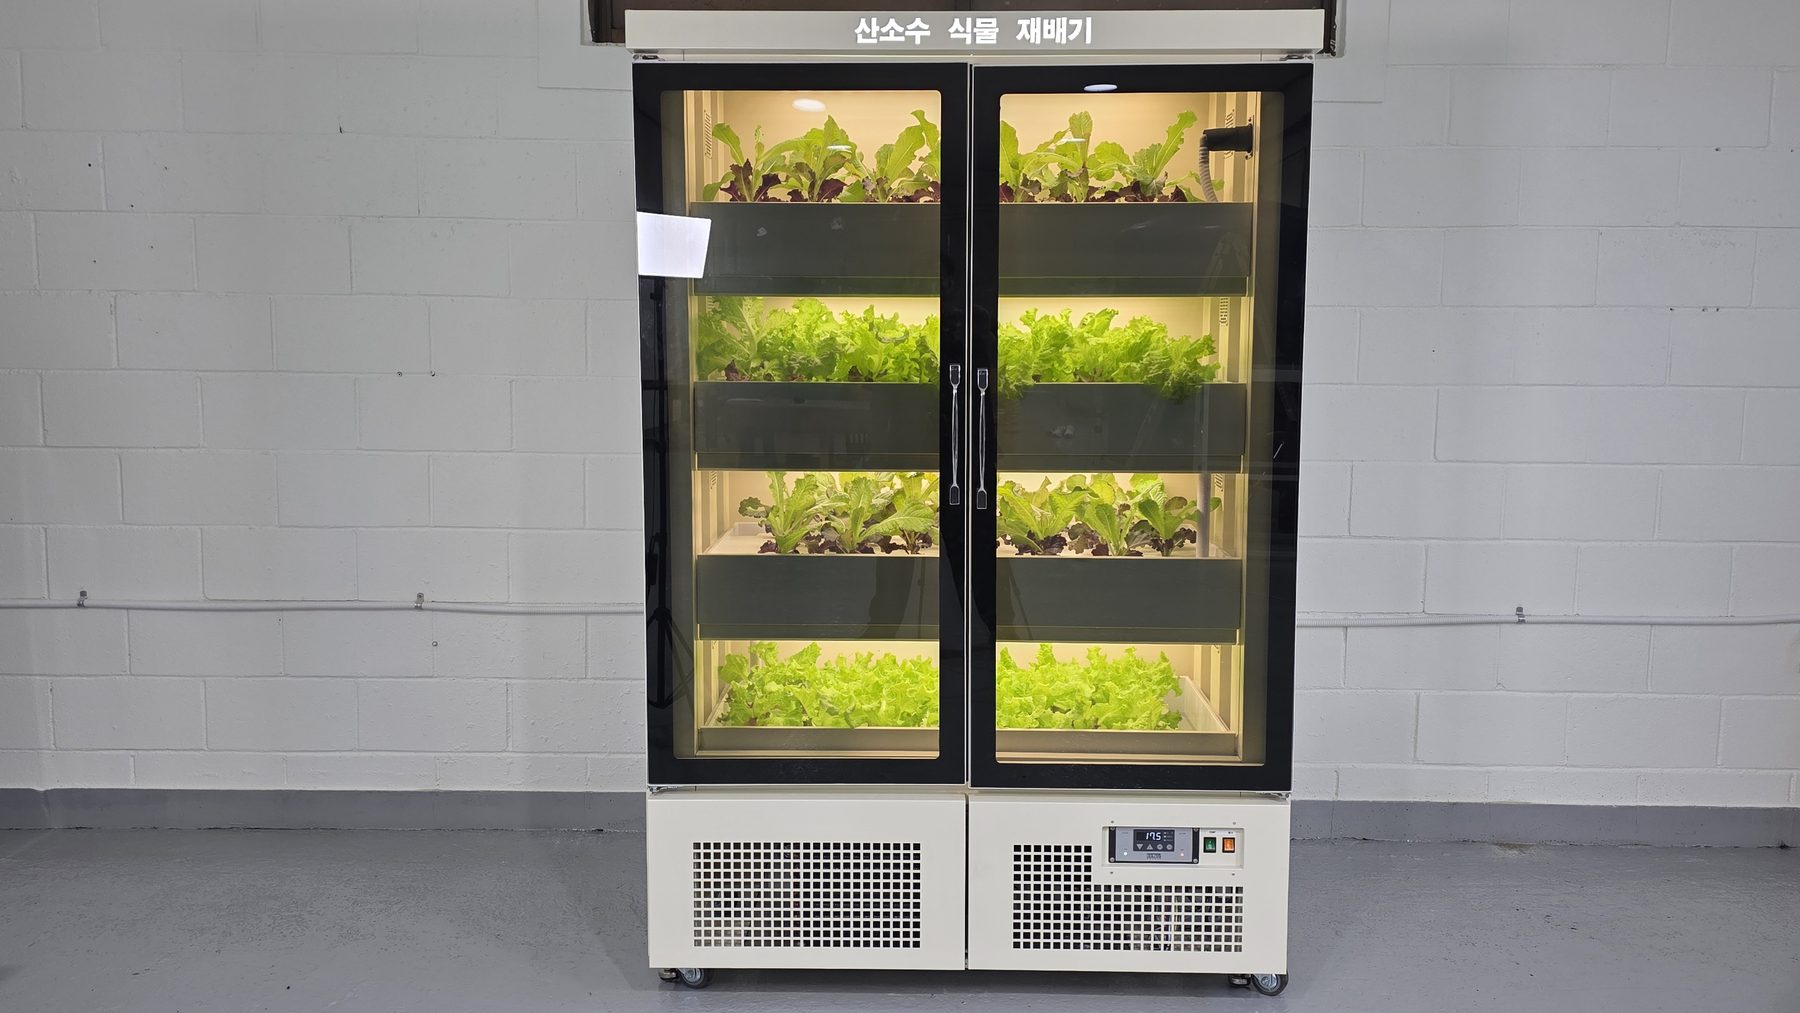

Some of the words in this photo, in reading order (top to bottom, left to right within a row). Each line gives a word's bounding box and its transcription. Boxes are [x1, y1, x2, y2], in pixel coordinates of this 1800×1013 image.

[854, 17, 931, 45] 산소수
[948, 17, 999, 45] 식물
[1016, 16, 1093, 45] 재배기
